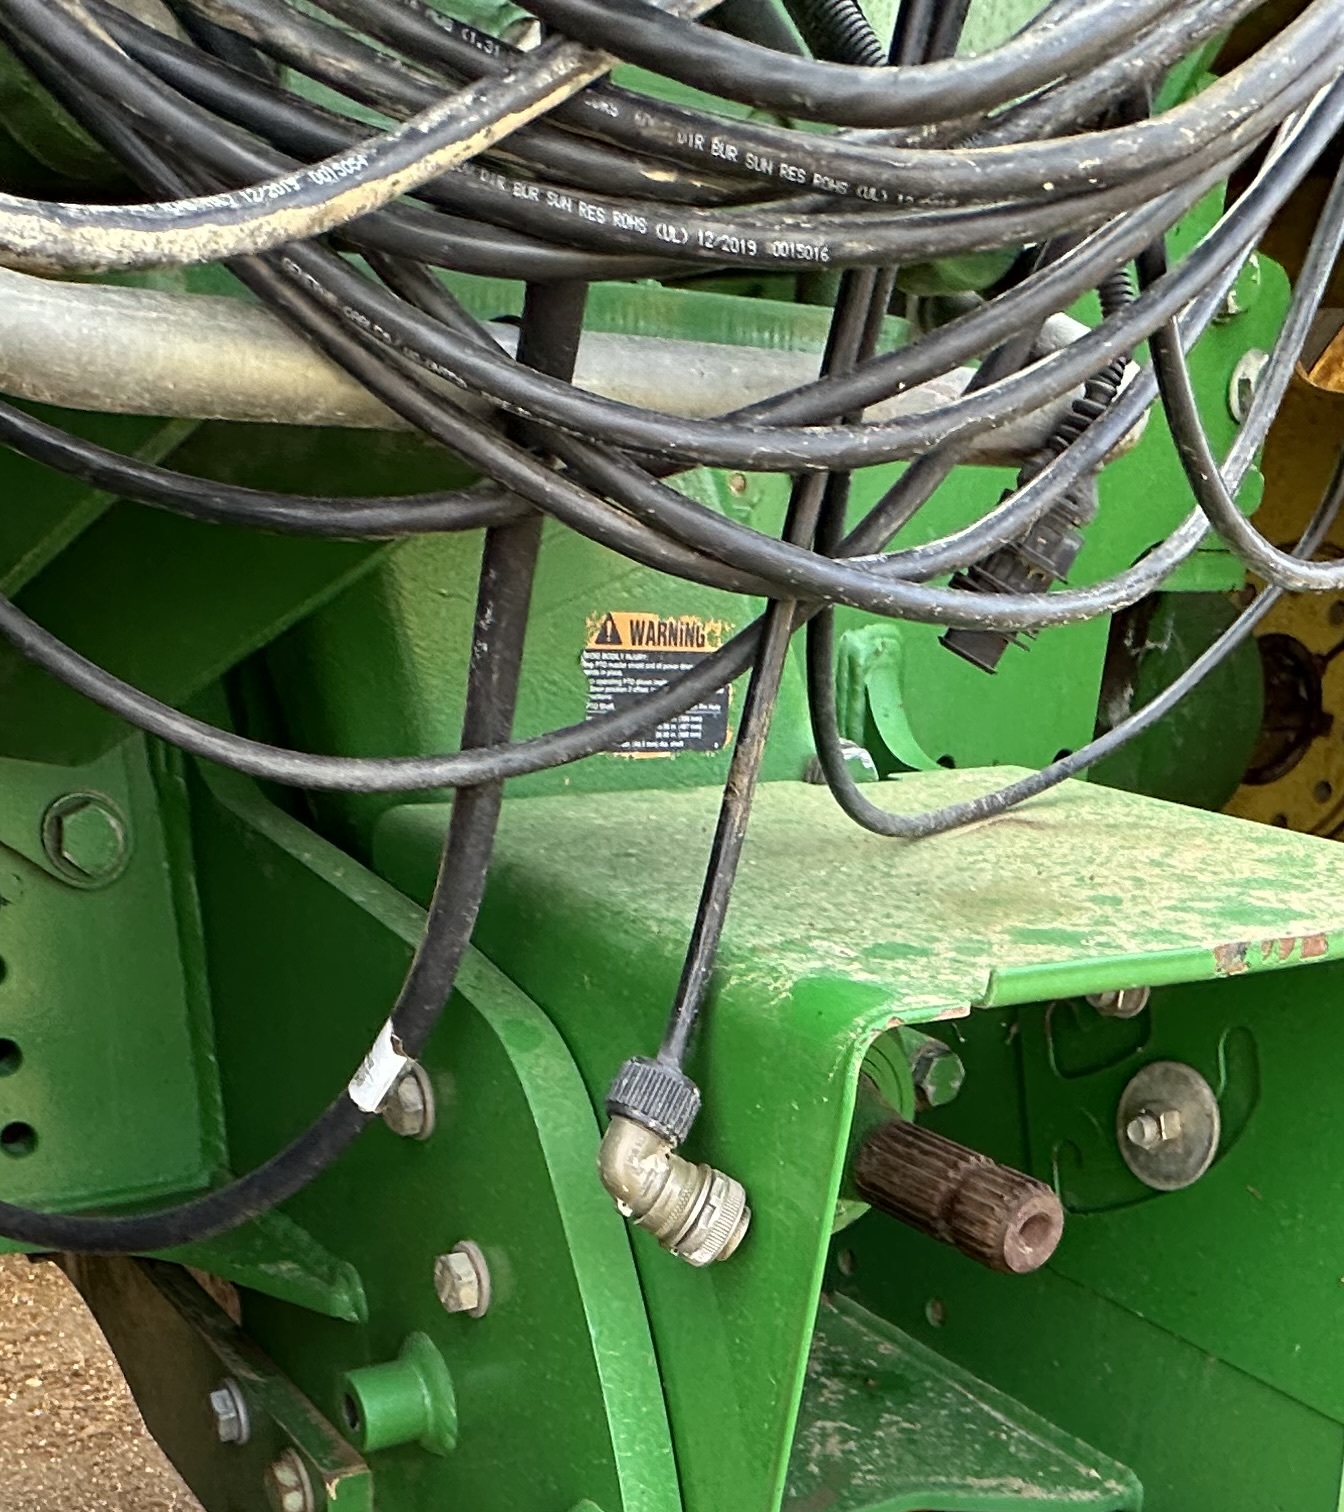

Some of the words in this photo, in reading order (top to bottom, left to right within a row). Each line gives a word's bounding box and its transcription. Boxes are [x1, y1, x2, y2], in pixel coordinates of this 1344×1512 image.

[710, 135, 739, 163] BUR
[744, 151, 773, 176] SUN
[778, 163, 807, 184] RES
[812, 172, 850, 195] ROHS
[512, 181, 541, 202] BUR
[545, 191, 573, 214] SUN
[578, 200, 607, 225] RES
[611, 209, 649, 235] ROHS
[655, 222, 689, 245] (UL)
[696, 227, 758, 257] 12/2019
[771, 240, 831, 263] 0015016
[630, 619, 706, 648] WARNING
